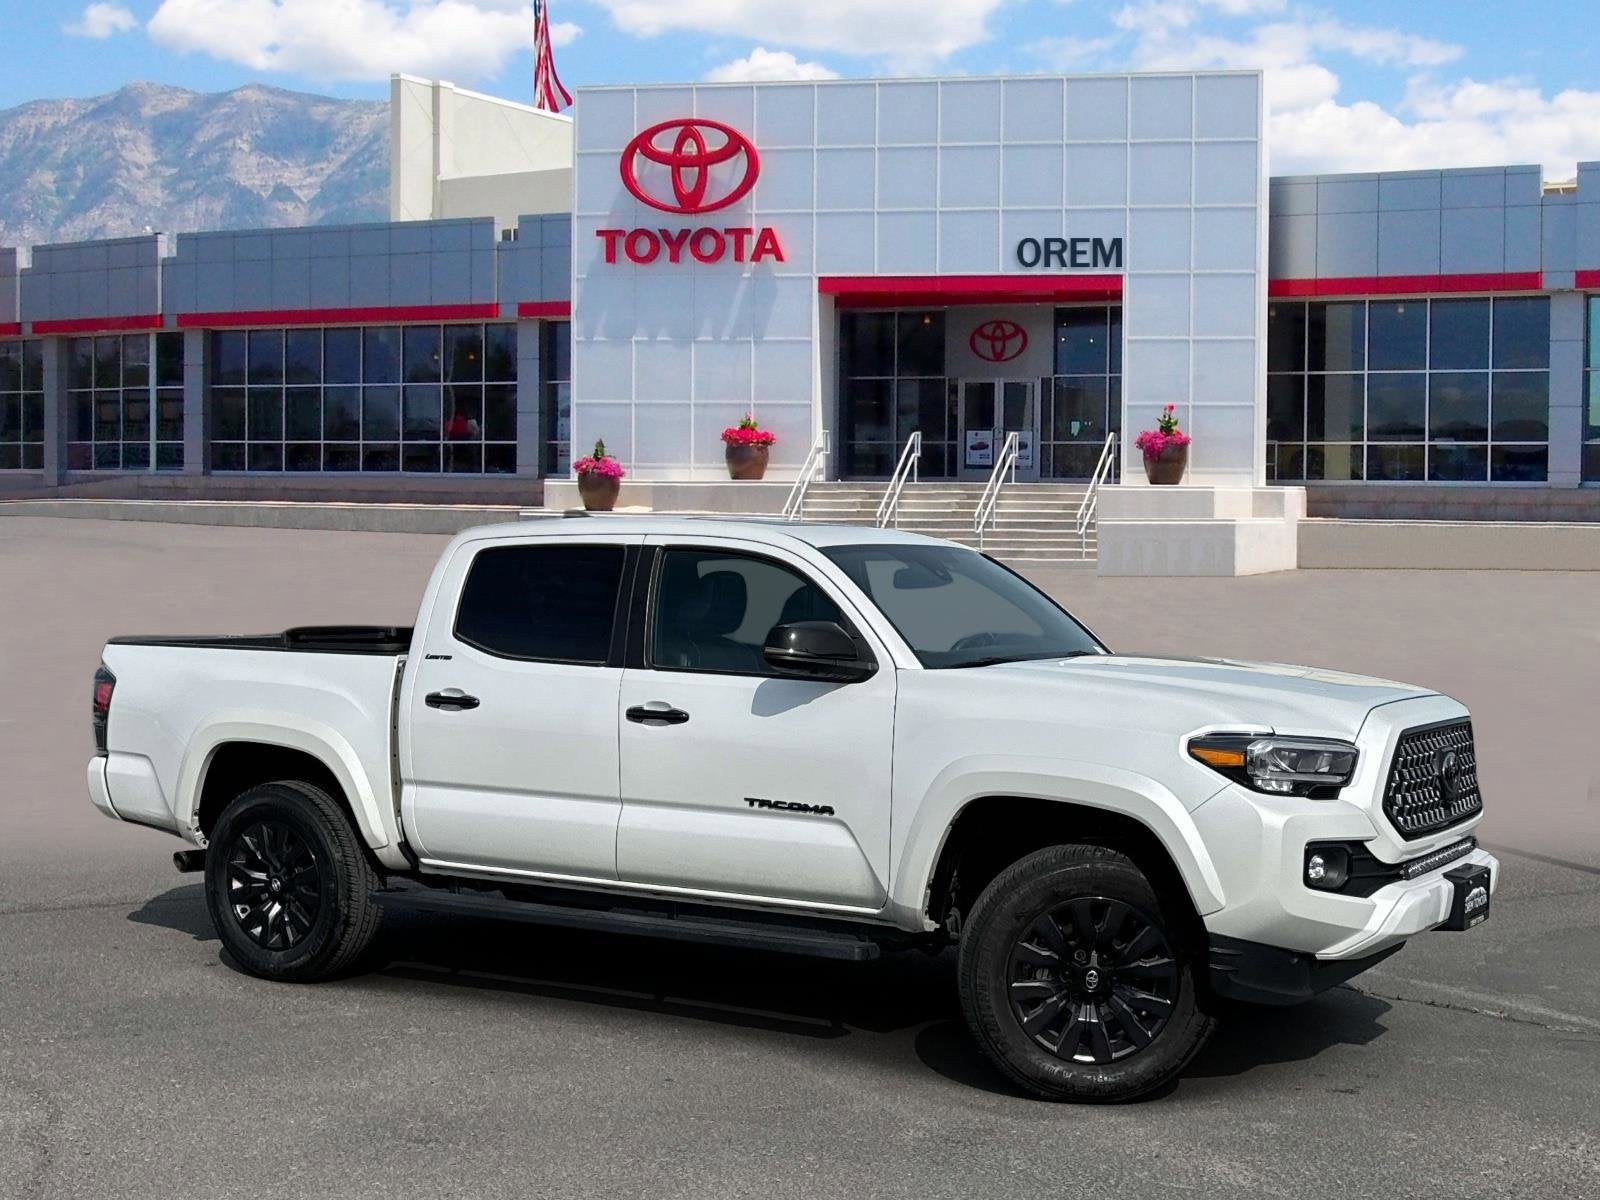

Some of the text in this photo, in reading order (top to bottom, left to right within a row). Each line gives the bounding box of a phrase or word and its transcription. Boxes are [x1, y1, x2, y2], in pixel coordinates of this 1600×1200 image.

[596, 227, 784, 264] TOYOTA
[1016, 237, 1123, 268] OREM
[744, 797, 835, 816] TACOMA
